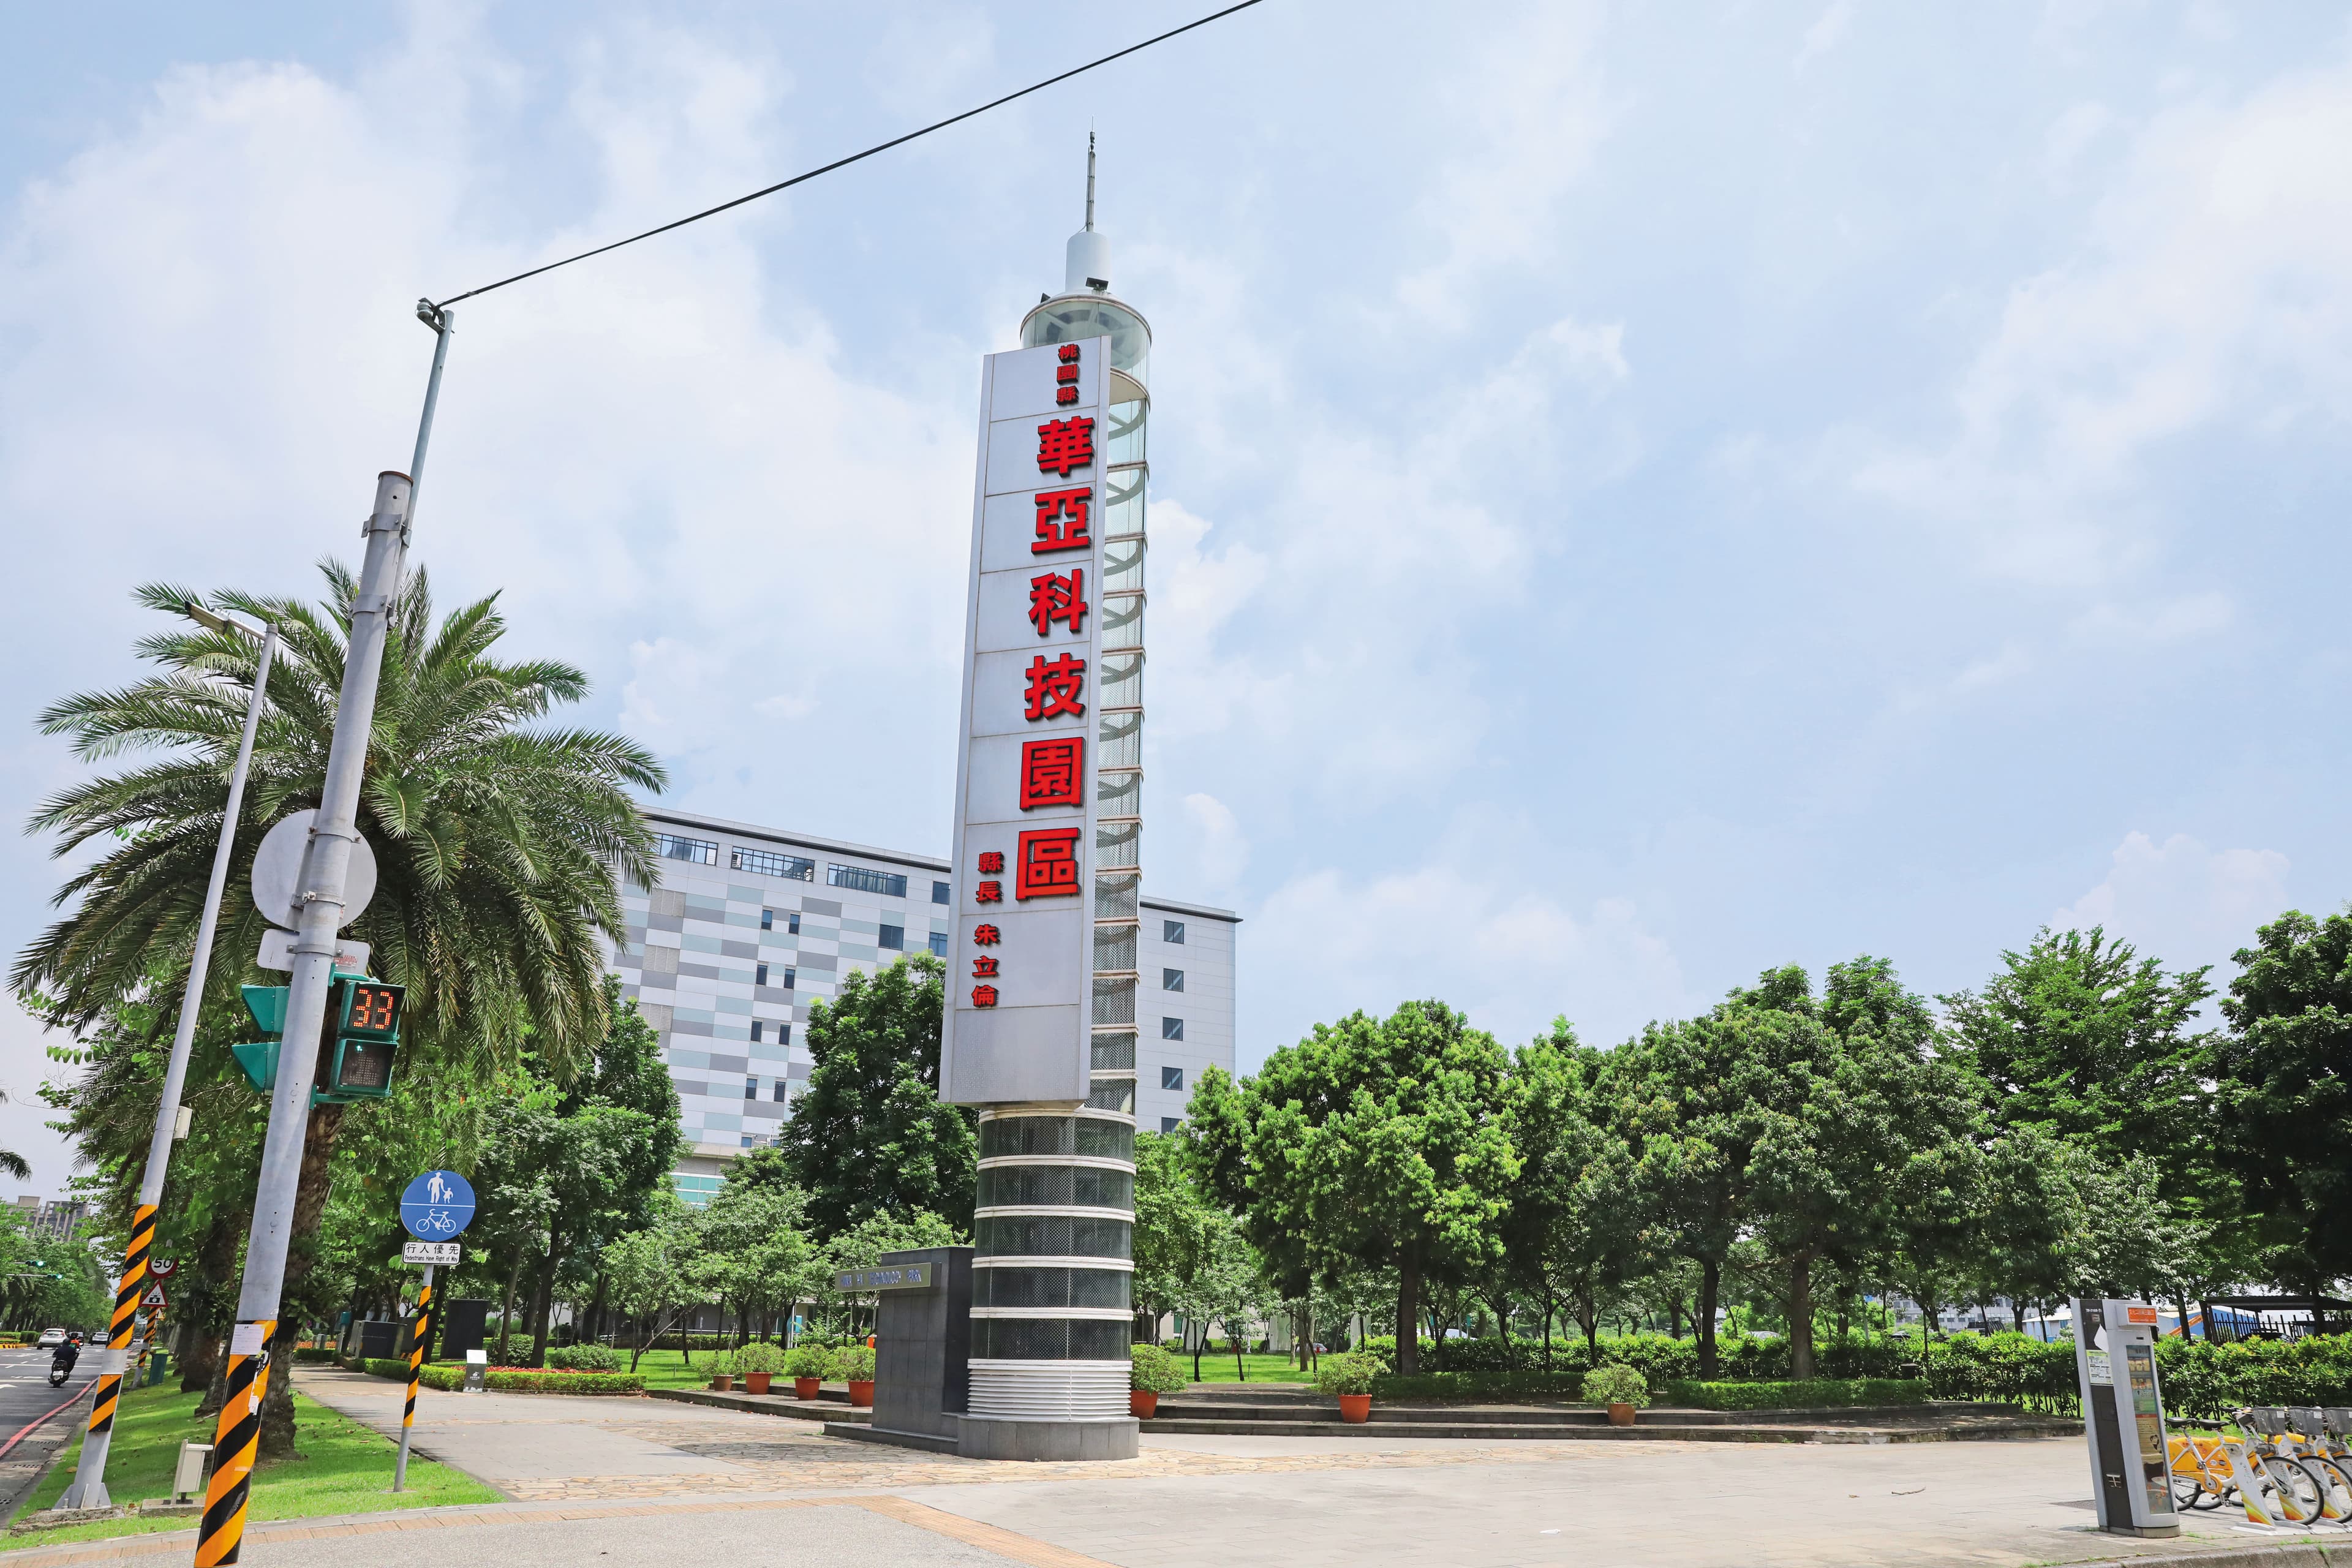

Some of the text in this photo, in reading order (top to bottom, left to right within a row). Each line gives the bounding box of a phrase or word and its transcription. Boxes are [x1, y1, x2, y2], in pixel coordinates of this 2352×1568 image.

[1057, 344, 1079, 404] 桃園縣
[1016, 415, 1095, 901] 華亞科技園區
[971, 851, 1003, 1008] 縣長 朱立倫
[353, 989, 394, 1030] 33
[154, 1258, 172, 1268] 50
[406, 1243, 459, 1255] 行人優先
